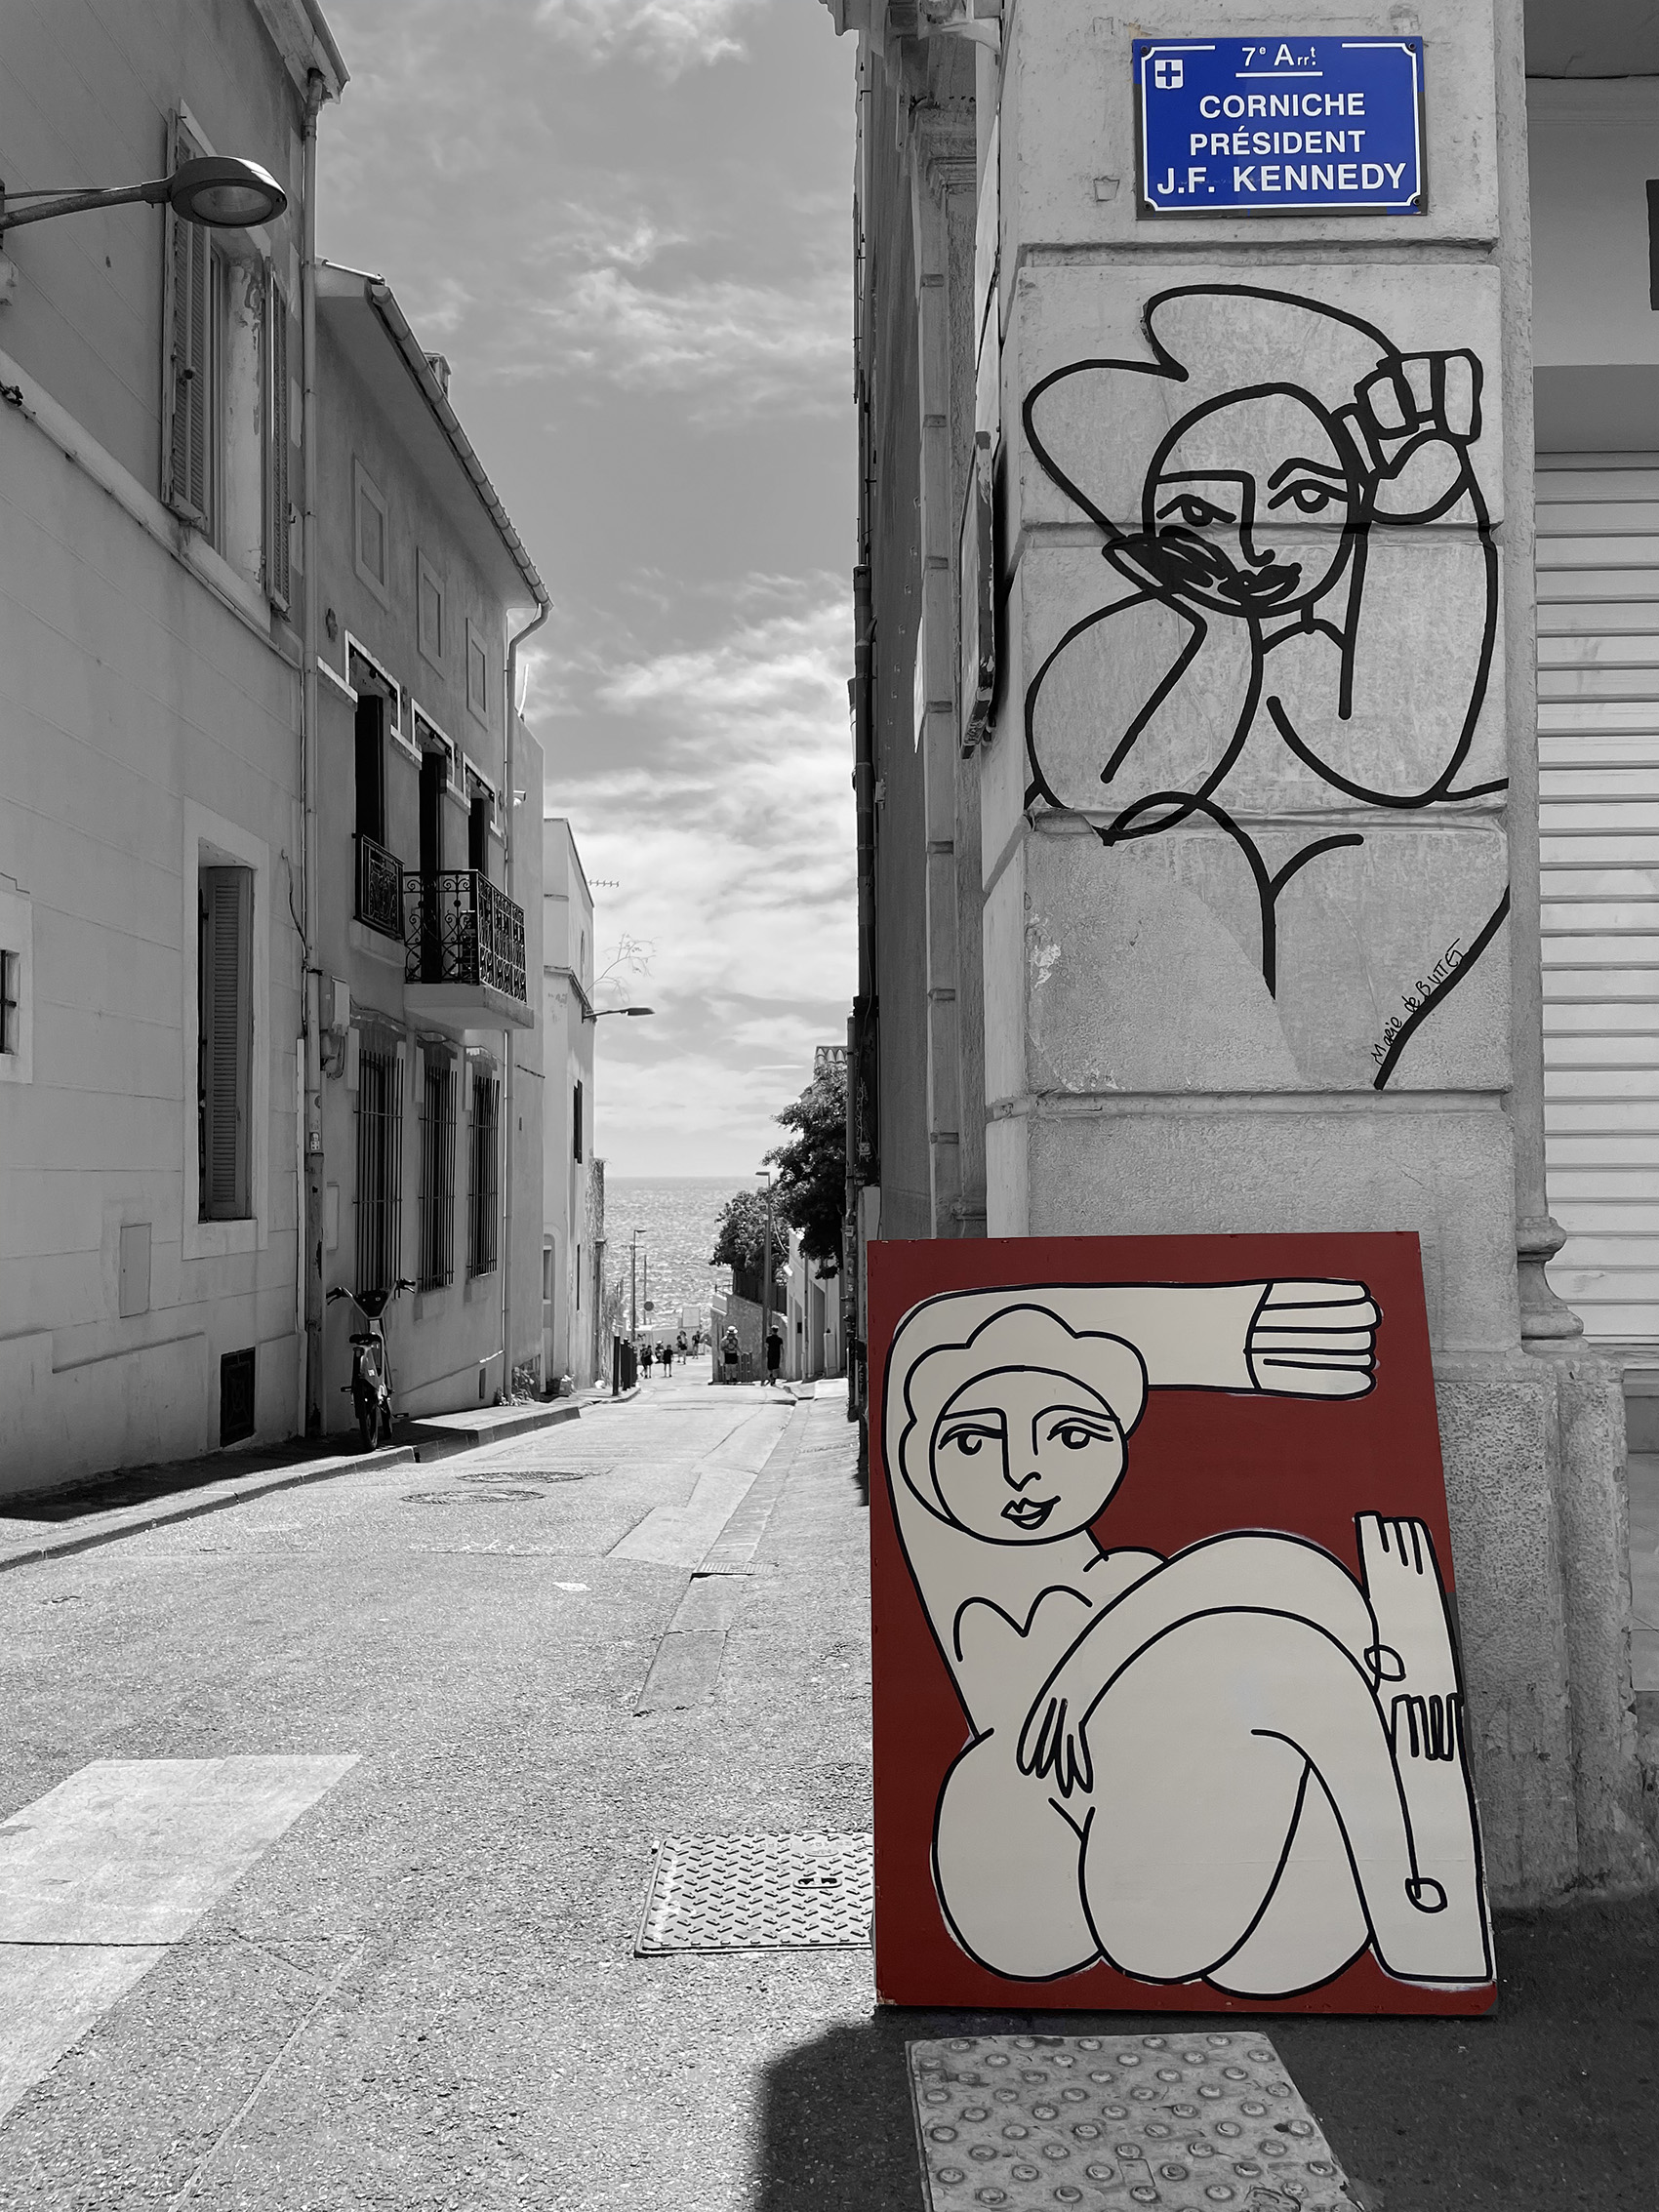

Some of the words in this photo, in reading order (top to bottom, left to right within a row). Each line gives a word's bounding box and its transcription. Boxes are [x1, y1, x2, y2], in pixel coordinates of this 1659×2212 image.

[1199, 93, 1365, 119] CORNICHE
[1190, 125, 1365, 156] PRÉSIDENT
[1156, 166, 1215, 194] J.F.
[1233, 162, 1406, 192] KENNEDY
